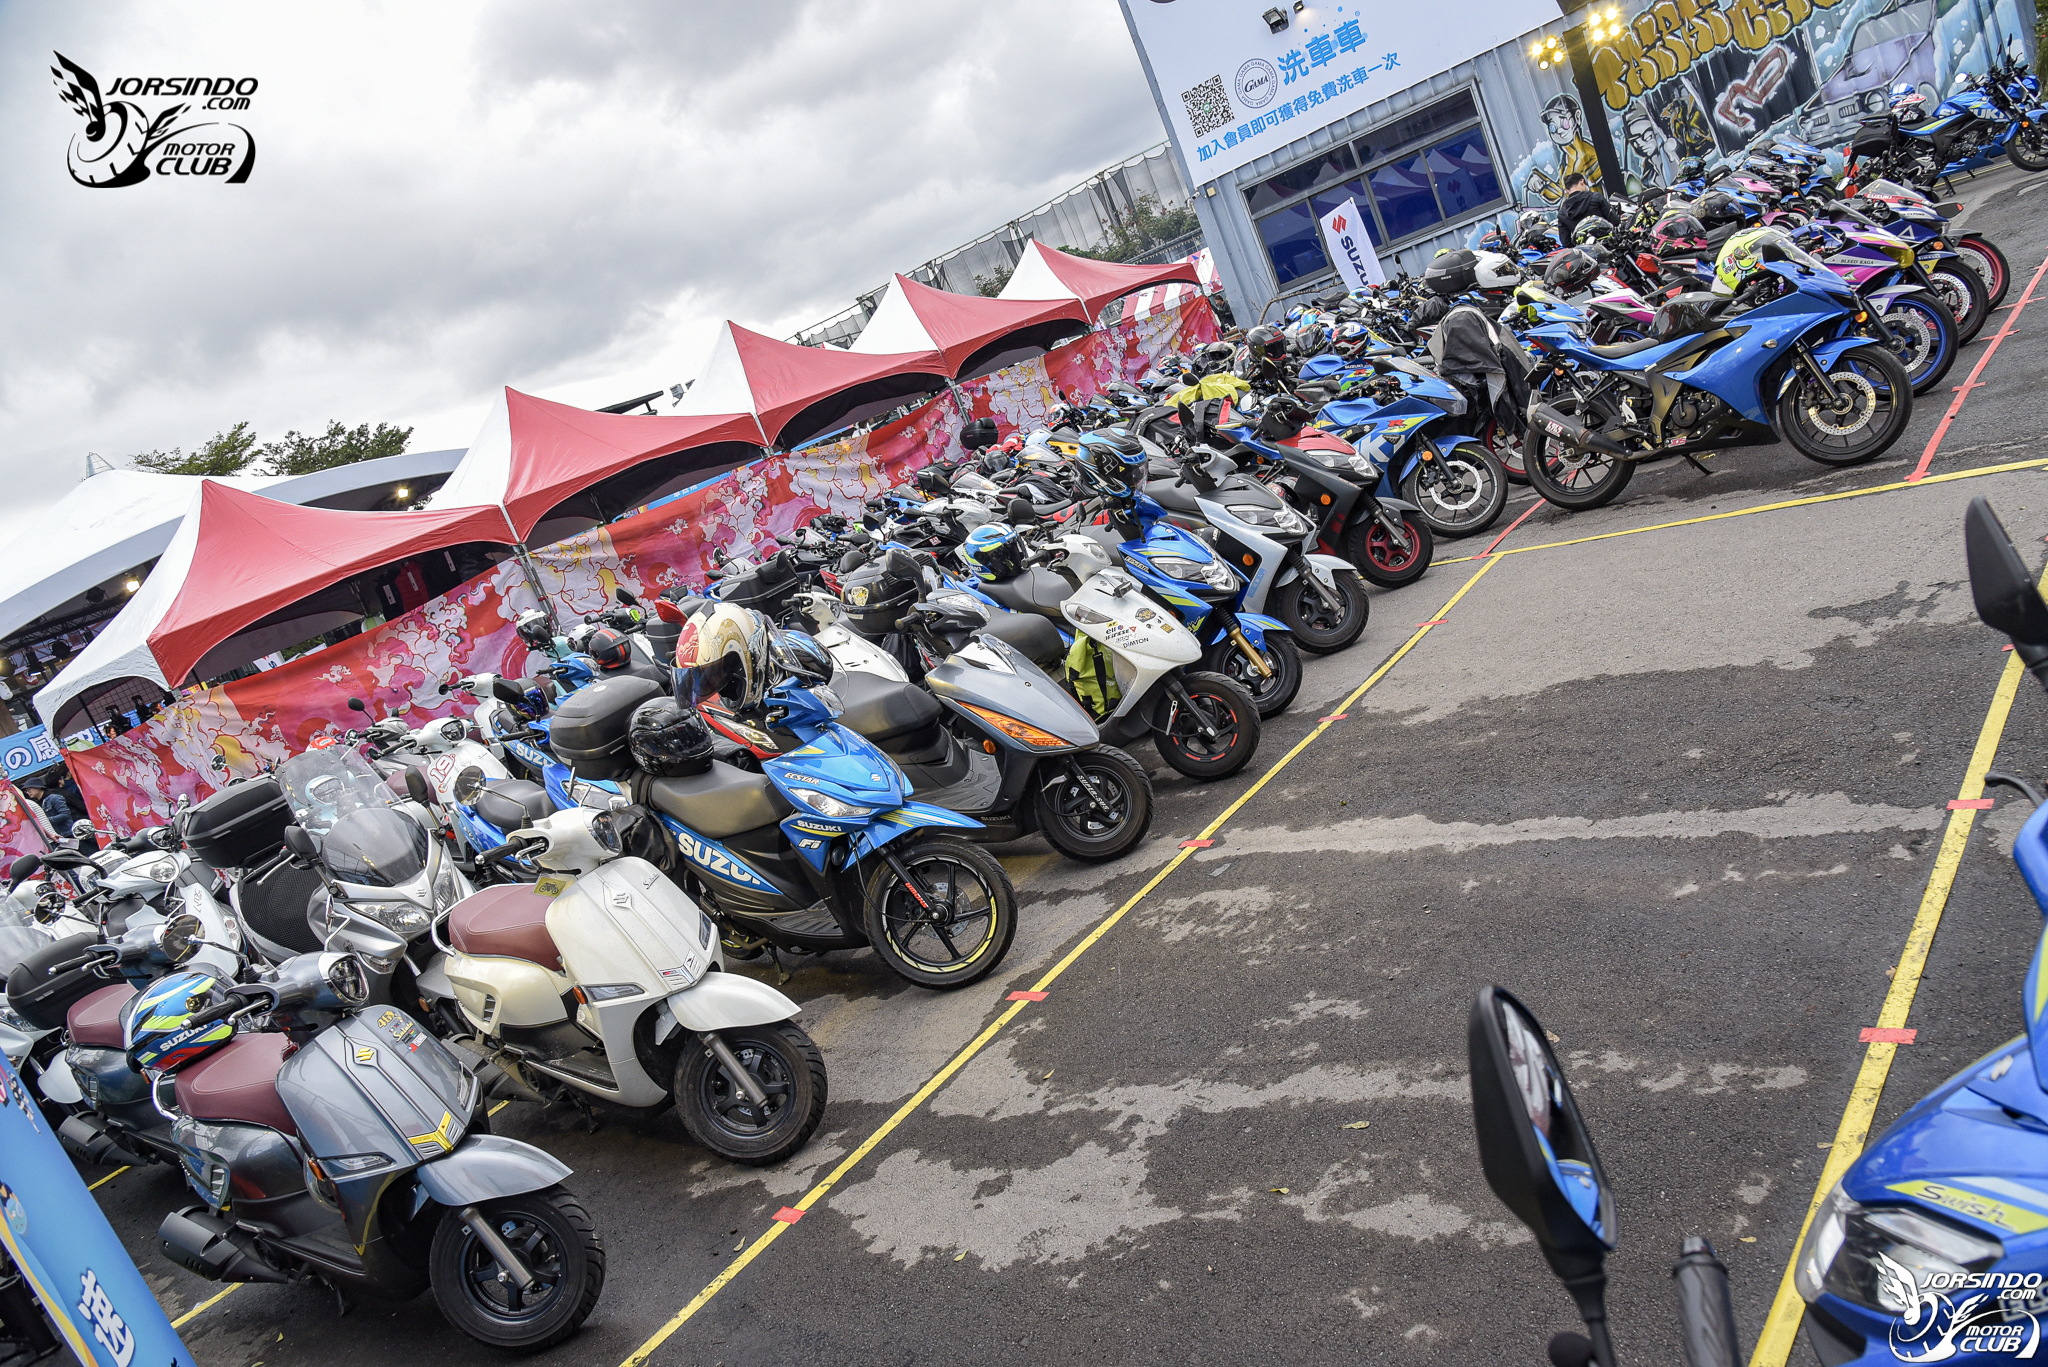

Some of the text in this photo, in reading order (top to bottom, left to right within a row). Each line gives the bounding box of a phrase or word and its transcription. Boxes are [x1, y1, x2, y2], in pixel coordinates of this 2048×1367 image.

[1277, 19, 1366, 85] 洗車車
[1244, 75, 1269, 93] GAMA
[1197, 52, 1401, 162] 加入會員即可獲得免費洗車一次
[784, 772, 821, 786] ECSTAR
[797, 820, 842, 832] SUZUKI
[1917, 1185, 2013, 1231] Swish
